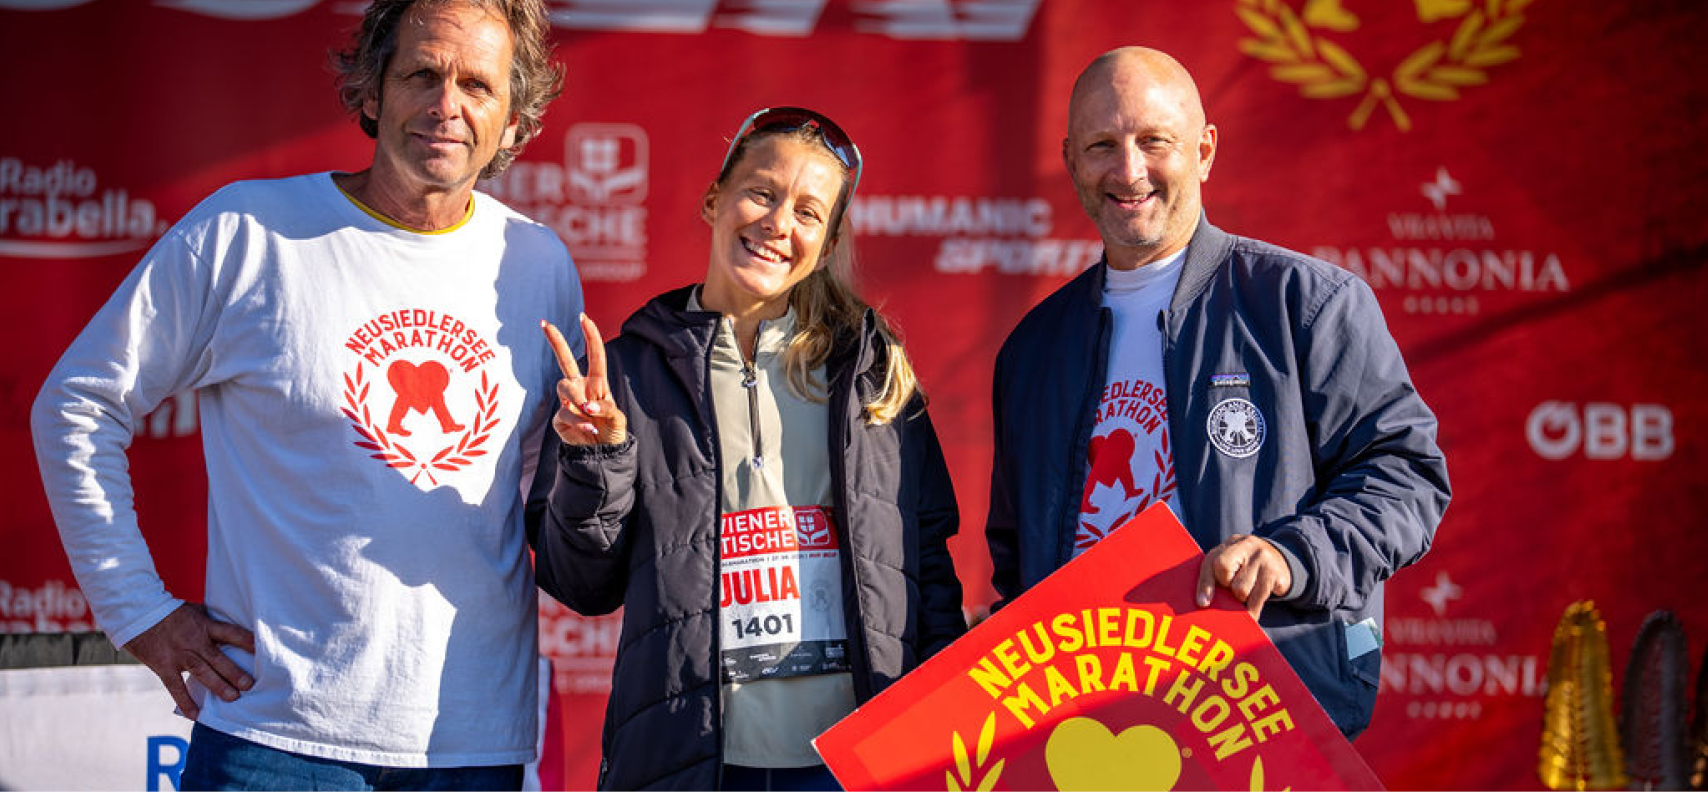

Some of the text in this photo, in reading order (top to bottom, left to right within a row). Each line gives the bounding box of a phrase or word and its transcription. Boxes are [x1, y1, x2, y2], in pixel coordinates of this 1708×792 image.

[851, 197, 1052, 236] HUMANIC
[345, 308, 496, 364] NEUSIEDLERSEE
[364, 329, 480, 373] MARATHON
[1525, 400, 1675, 461] ÖBB
[721, 530, 795, 555] TISCHE
[721, 566, 800, 607] JULIA
[731, 613, 793, 639] 1401
[967, 607, 1295, 744] NEUSIEDLERSEE
[1378, 652, 1548, 697] NNONI
[1002, 652, 1253, 762] MARATHON
